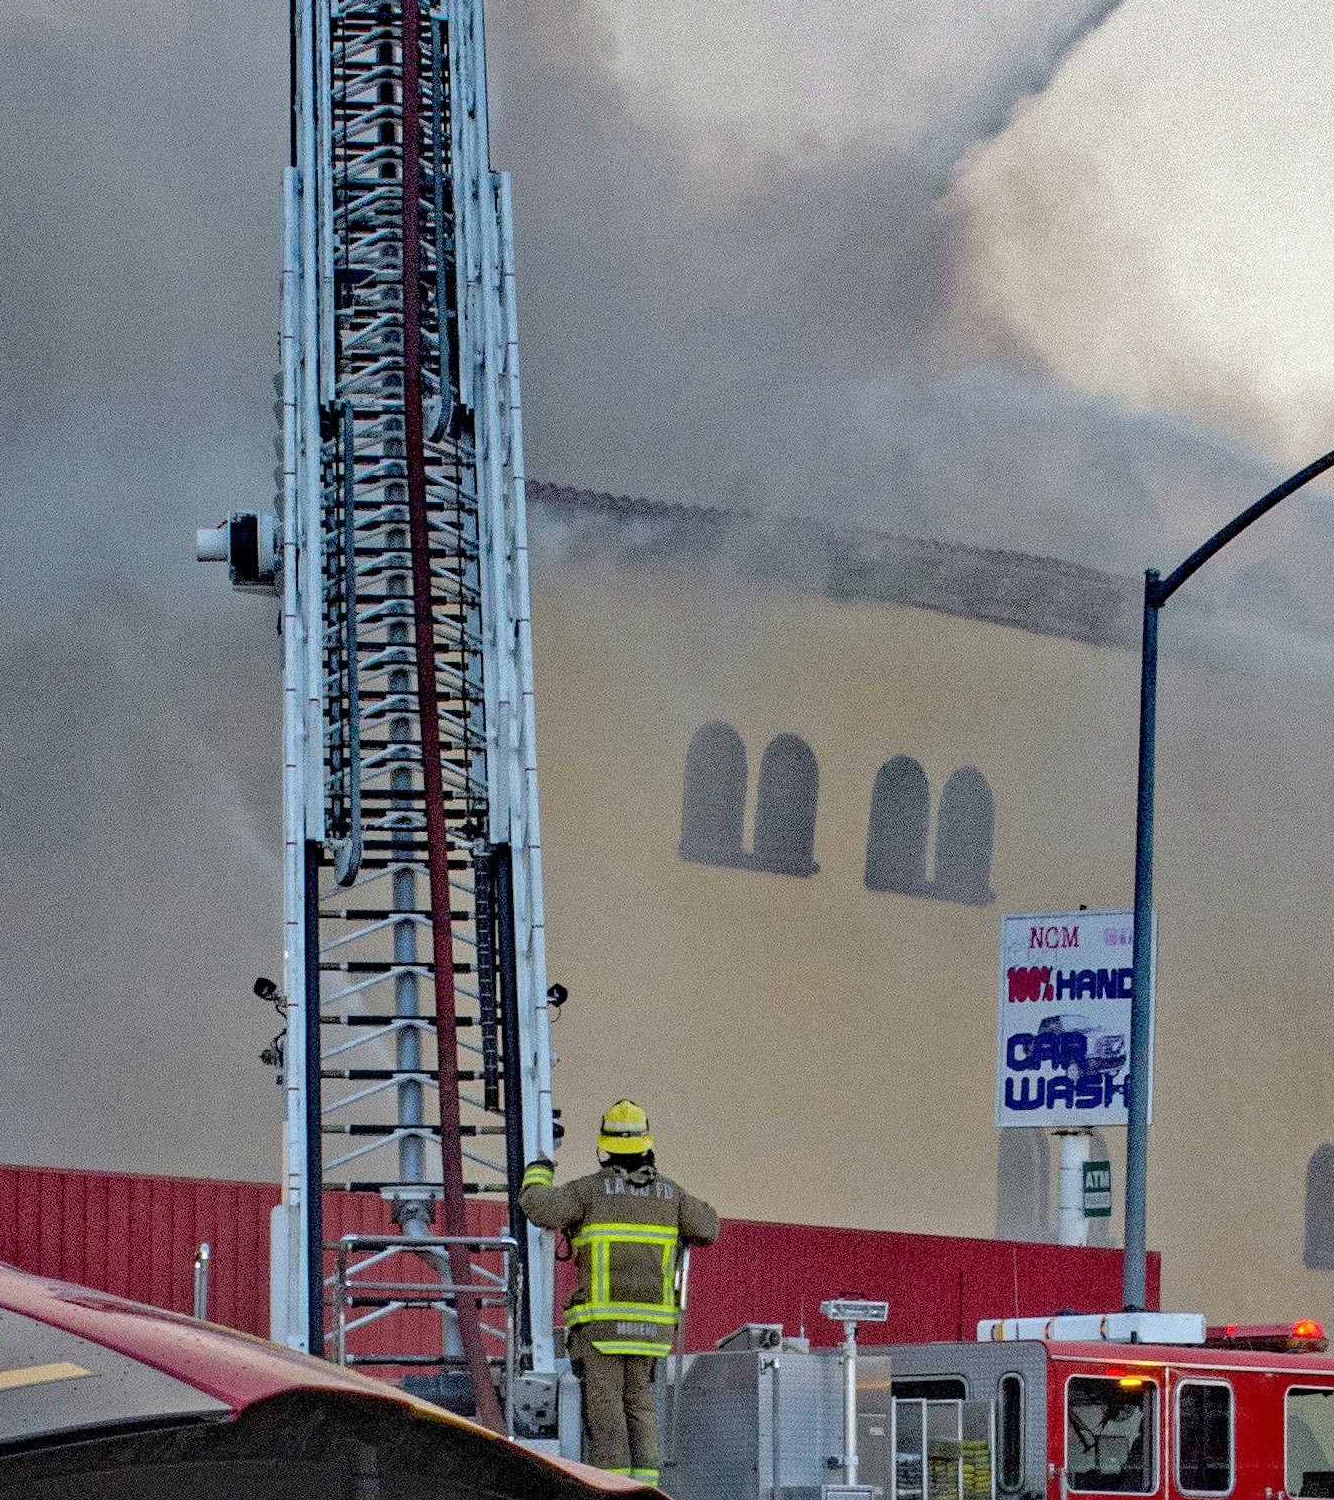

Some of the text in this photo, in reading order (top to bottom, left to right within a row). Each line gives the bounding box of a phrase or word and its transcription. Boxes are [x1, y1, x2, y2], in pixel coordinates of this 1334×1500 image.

[1007, 965, 1135, 1003] 100% HAND
[1006, 1031, 1088, 1071] CAR
[1004, 1073, 1130, 1111] WASH
[604, 1177, 625, 1194] LA
[1085, 1171, 1110, 1189] ATM
